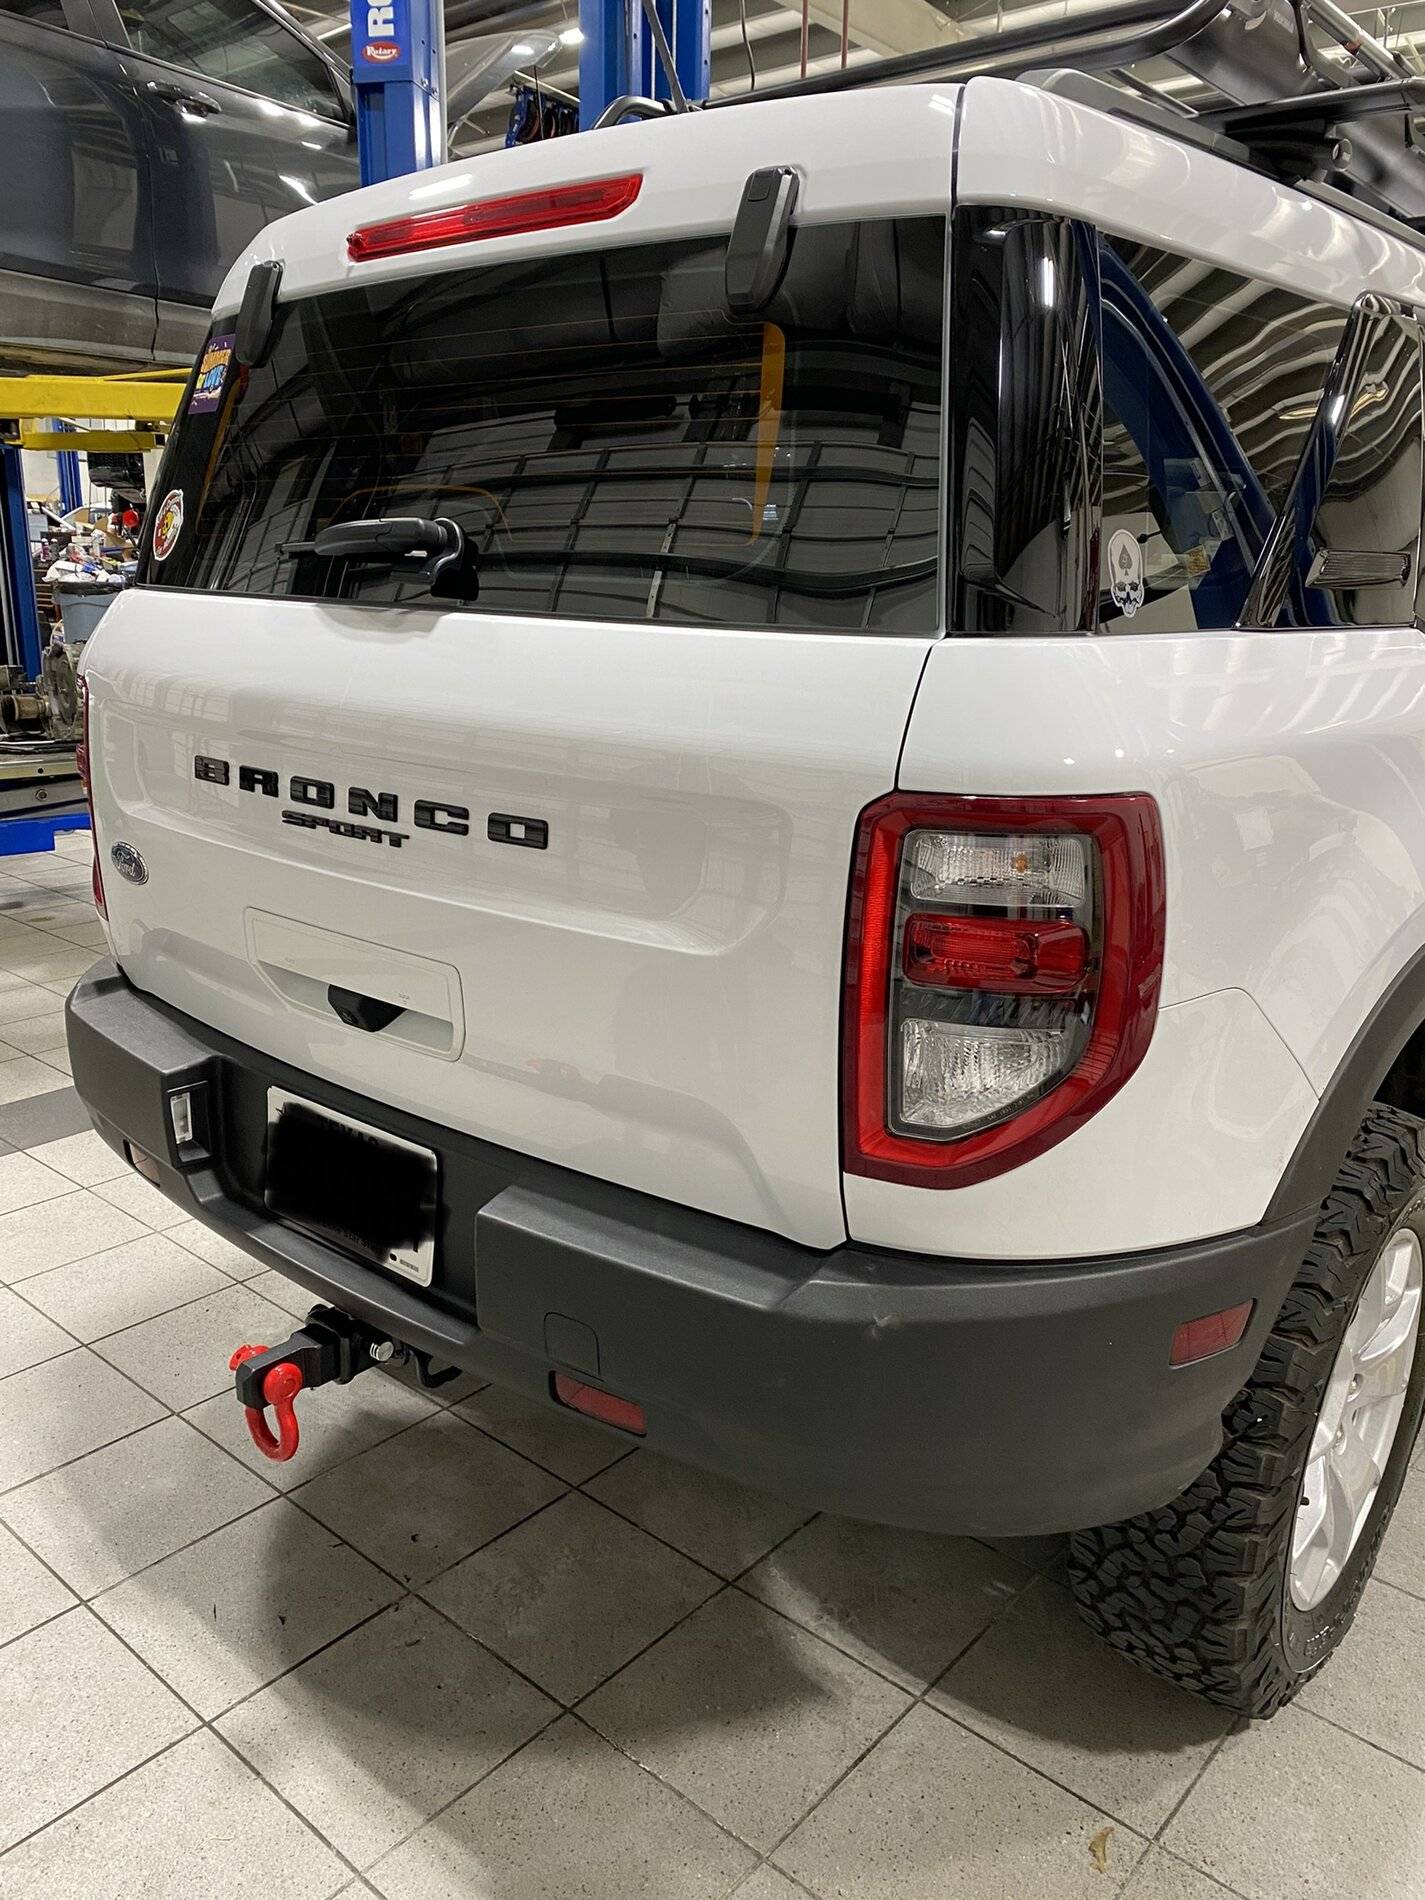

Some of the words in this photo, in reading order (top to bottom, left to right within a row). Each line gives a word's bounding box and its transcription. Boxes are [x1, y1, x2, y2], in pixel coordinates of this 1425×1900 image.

[366, 45, 397, 58] Rotary
[194, 755, 549, 850] BRONCO
[281, 810, 410, 848] SPORT
[112, 849, 136, 877] Ford
